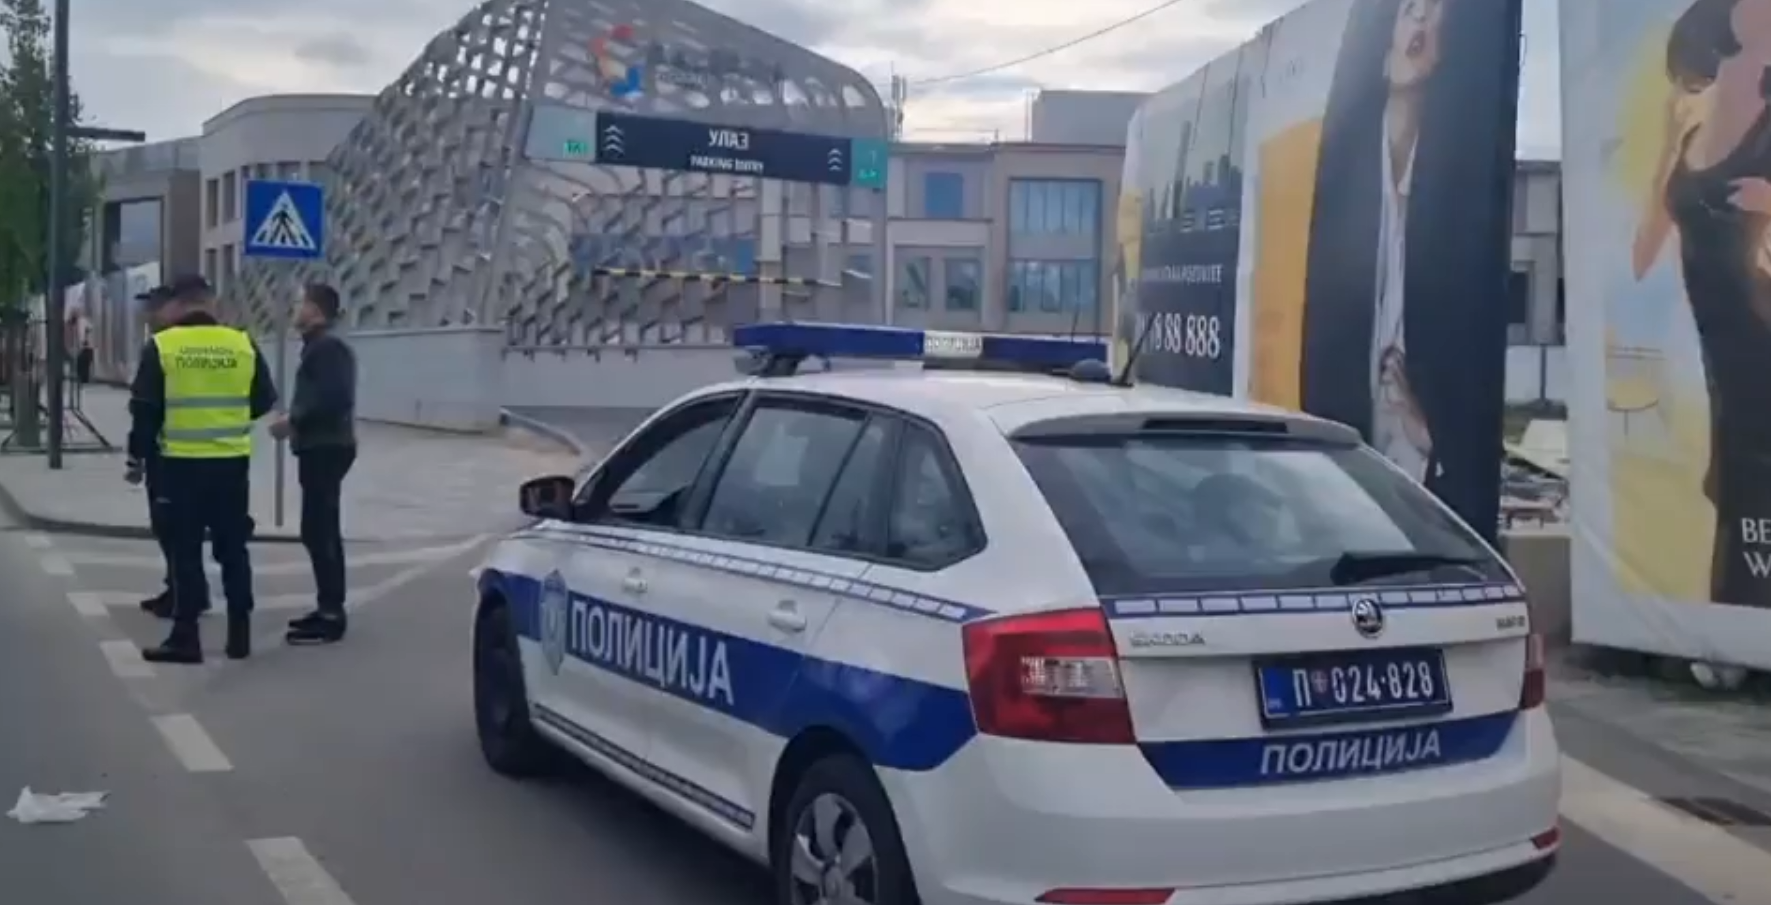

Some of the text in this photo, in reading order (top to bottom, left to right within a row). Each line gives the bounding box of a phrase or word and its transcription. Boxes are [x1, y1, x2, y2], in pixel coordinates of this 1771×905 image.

[708, 128, 750, 151] УЛАЗ
[1185, 314, 1221, 358] 888
[570, 600, 735, 706] ПОЛИЦИЈА
[1259, 728, 1442, 776] ПОЛИЦИЈА
